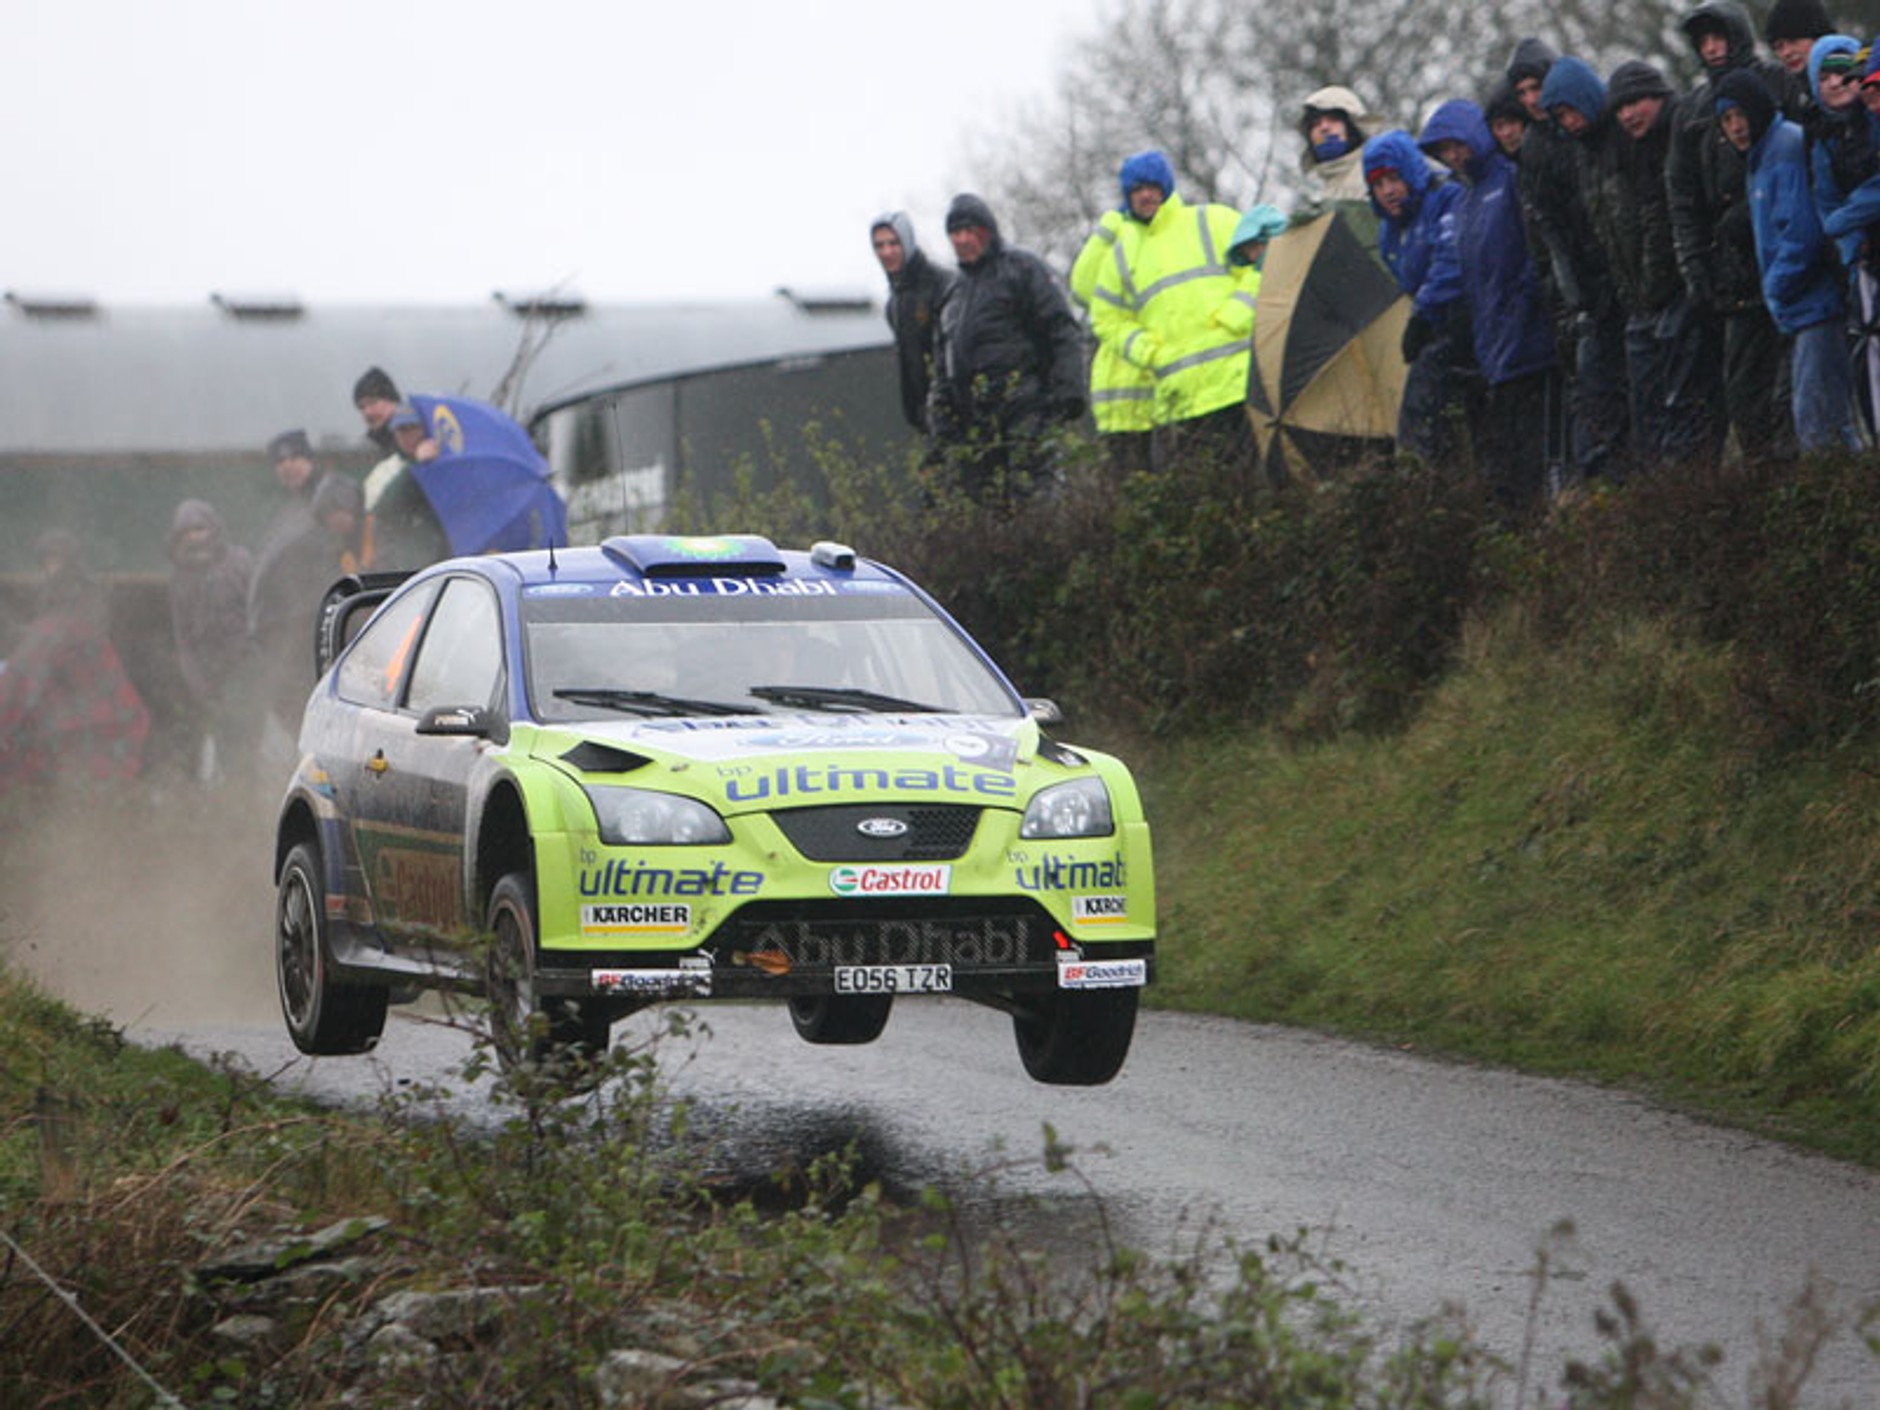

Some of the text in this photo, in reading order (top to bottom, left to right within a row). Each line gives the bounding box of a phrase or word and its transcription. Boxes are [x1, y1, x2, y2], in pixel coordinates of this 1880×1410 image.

[610, 579, 700, 597] Abu
[717, 764, 752, 778] bp
[725, 764, 1017, 801] ultimate
[580, 847, 597, 865] bp
[579, 859, 765, 896] ultimate
[860, 868, 943, 892] Castrol
[753, 920, 868, 968] Abu
[836, 966, 951, 992] EO56 TZR
